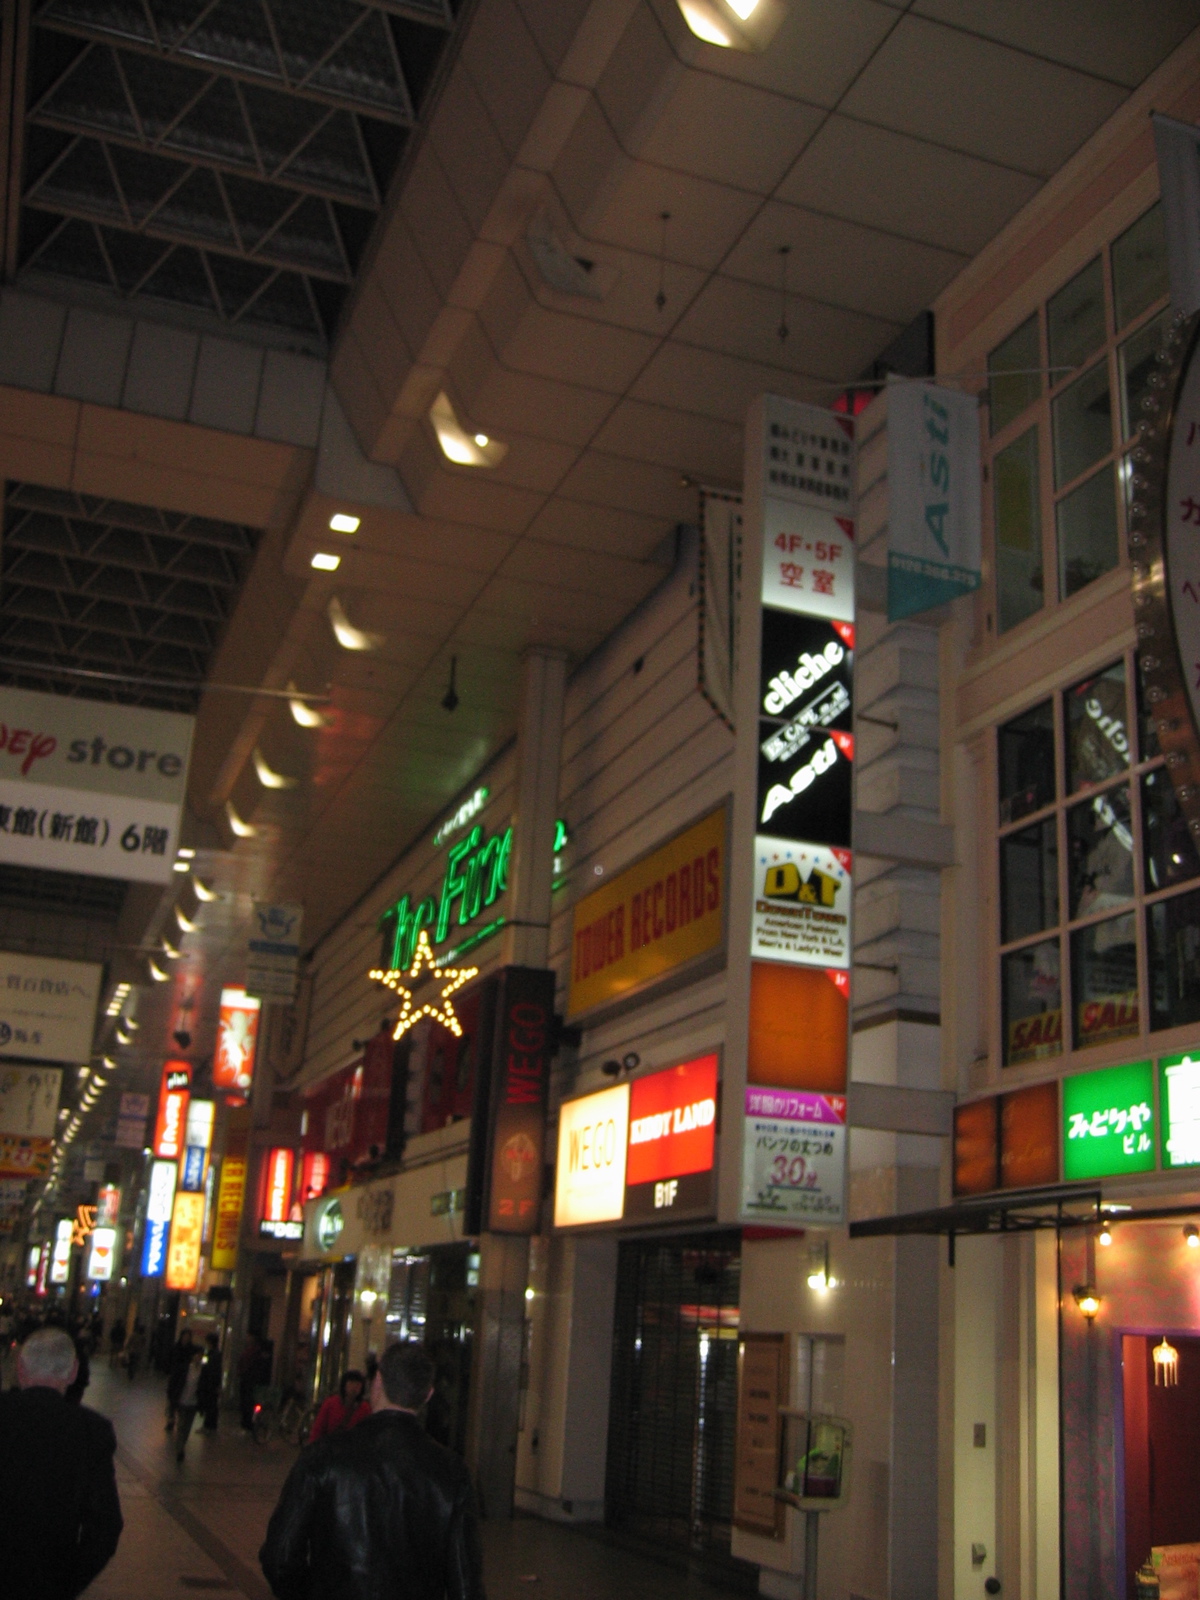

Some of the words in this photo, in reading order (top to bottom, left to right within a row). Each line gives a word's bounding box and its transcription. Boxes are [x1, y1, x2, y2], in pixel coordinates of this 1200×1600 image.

[779, 562, 835, 596] 空室
[763, 641, 844, 716] cliche
[67, 736, 183, 777] store
[761, 737, 838, 824] Asti
[574, 903, 625, 983] TOWER
[630, 846, 720, 954] RECORDS
[506, 1002, 546, 1104] WEGO
[673, 1098, 716, 1134] LAND
[1068, 1101, 1151, 1140] みどりや
[568, 1117, 617, 1175] WEGO
[1122, 1132, 1151, 1155] ビル
[654, 1180, 679, 1209] B1F
